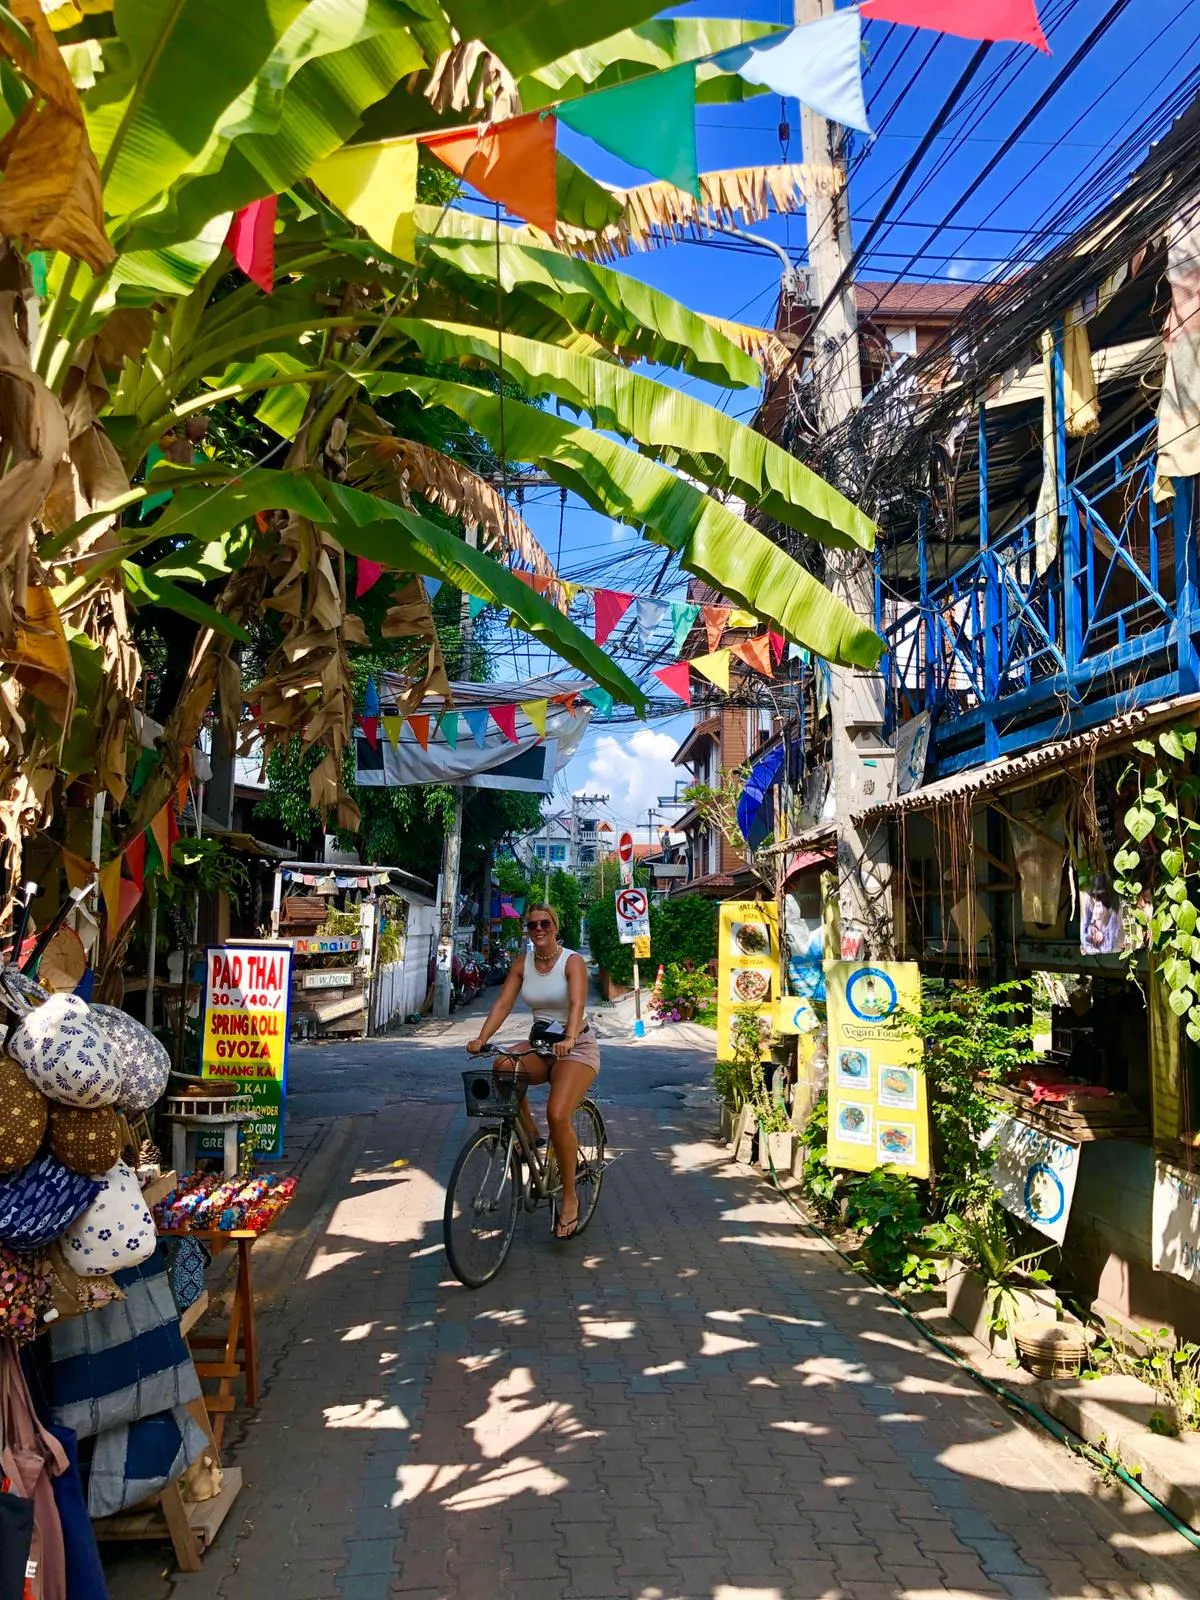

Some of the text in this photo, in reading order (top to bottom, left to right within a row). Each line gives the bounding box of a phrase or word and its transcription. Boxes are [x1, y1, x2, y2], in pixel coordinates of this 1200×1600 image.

[212, 955, 284, 991] PAD THAI
[211, 1013, 278, 1036] SPRING ROLL
[845, 1027, 874, 1039] Vegan
[216, 1040, 271, 1058] GYOZA
[209, 1064, 277, 1077] PANANG KAI
[244, 1083, 267, 1095] KAI
[255, 1123, 277, 1135] CURRY
